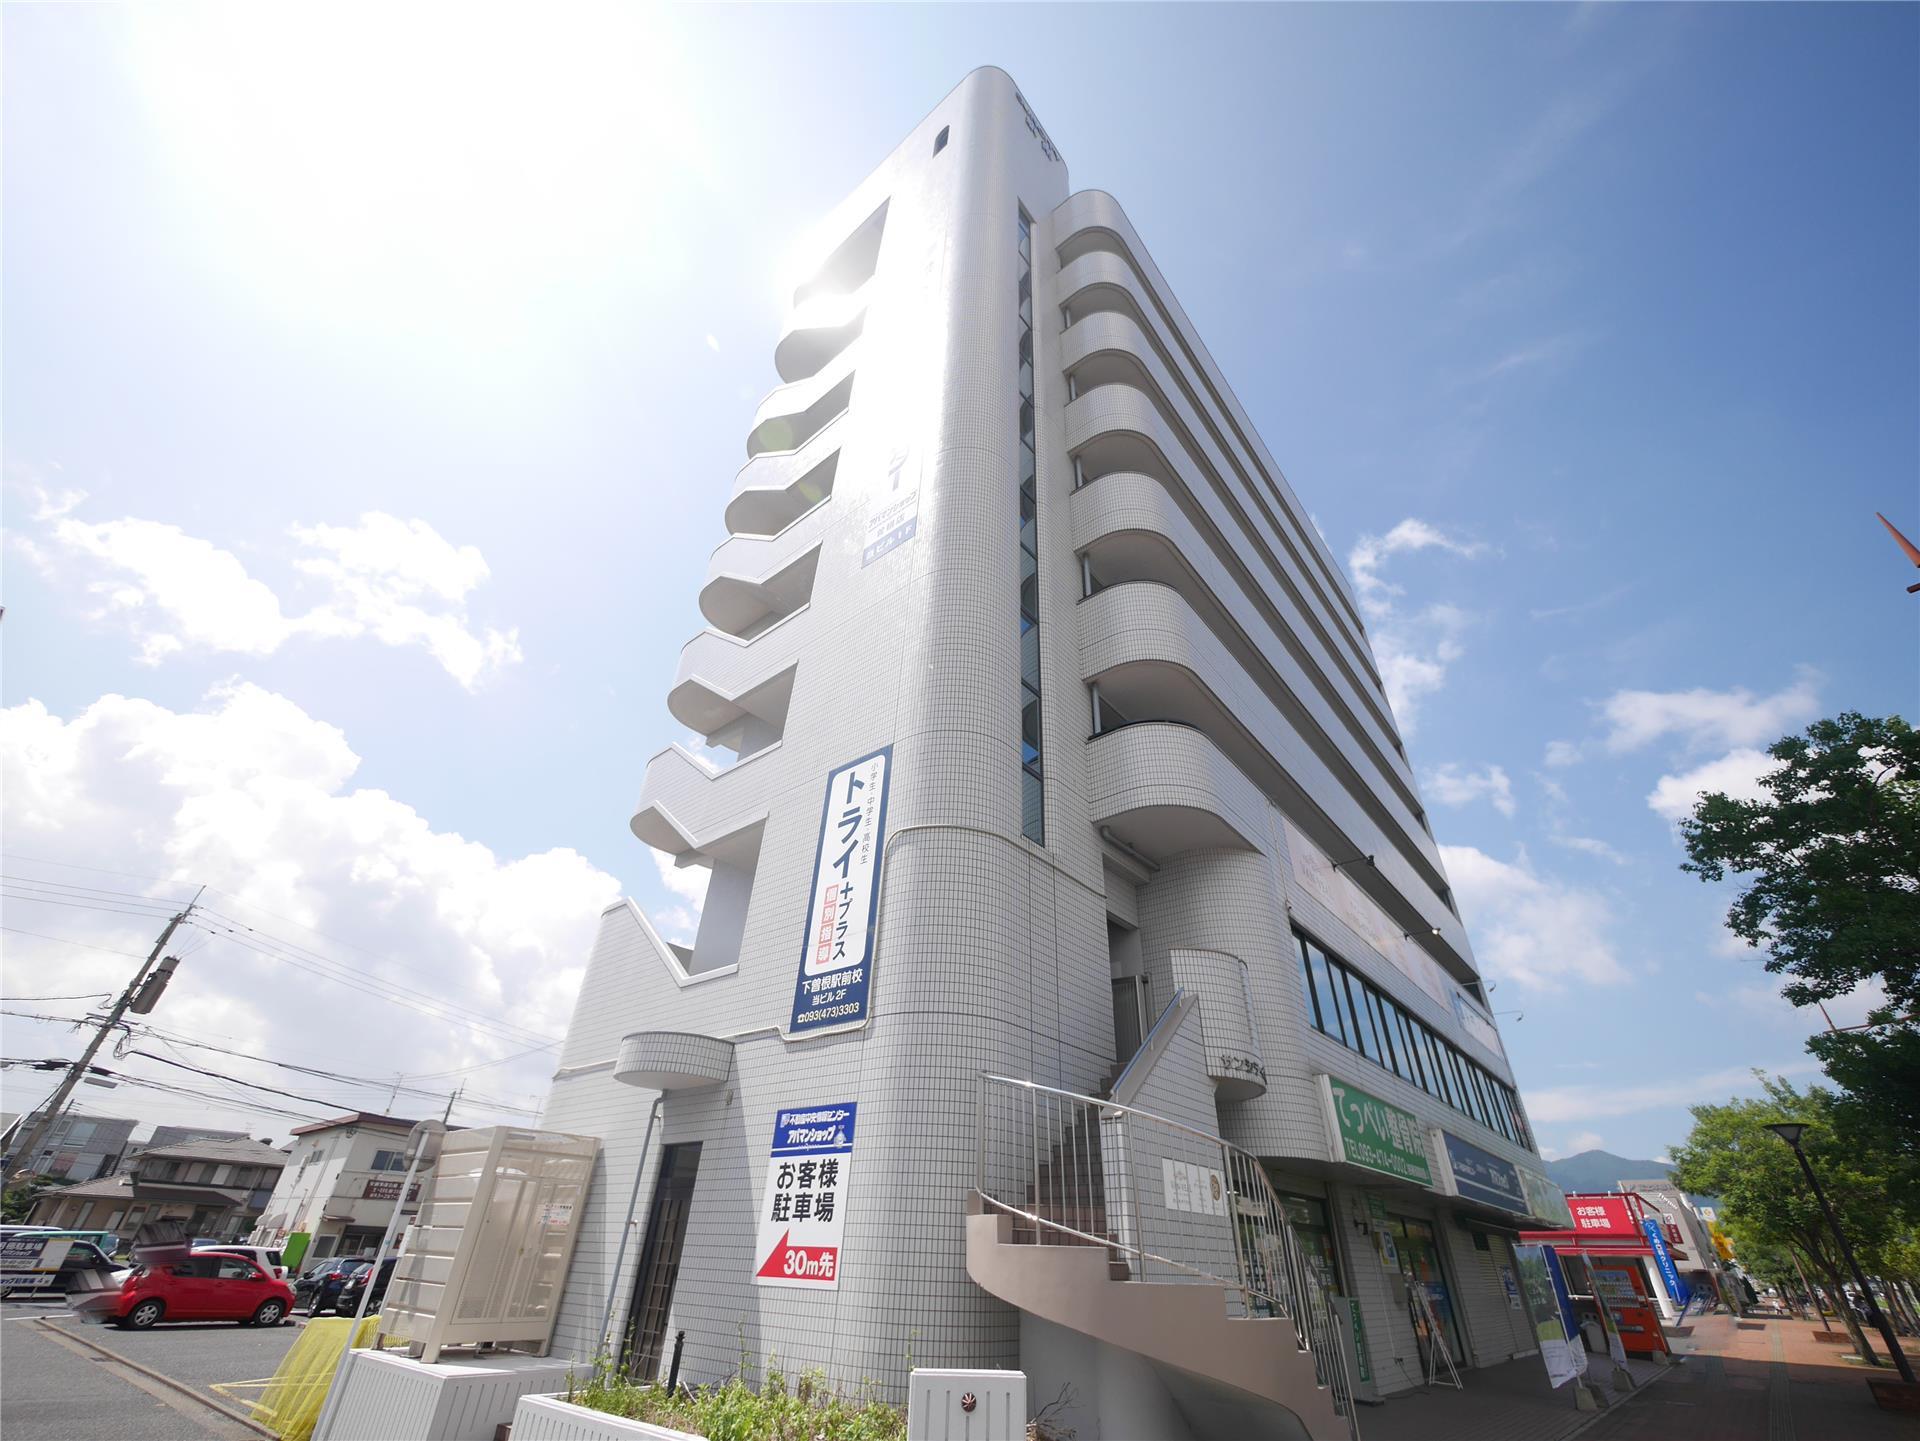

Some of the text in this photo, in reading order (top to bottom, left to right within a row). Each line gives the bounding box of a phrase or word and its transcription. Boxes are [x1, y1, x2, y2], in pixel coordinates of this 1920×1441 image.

[802, 968, 864, 995] 下曽根駅前校
[787, 1124, 837, 1144] アパマンショップ
[776, 1158, 839, 1190] お客様
[771, 1191, 835, 1223] 駐車場
[1576, 1206, 1606, 1216] お客様
[1580, 1218, 1611, 1229] 駐車場
[783, 1249, 834, 1278] 30m先
